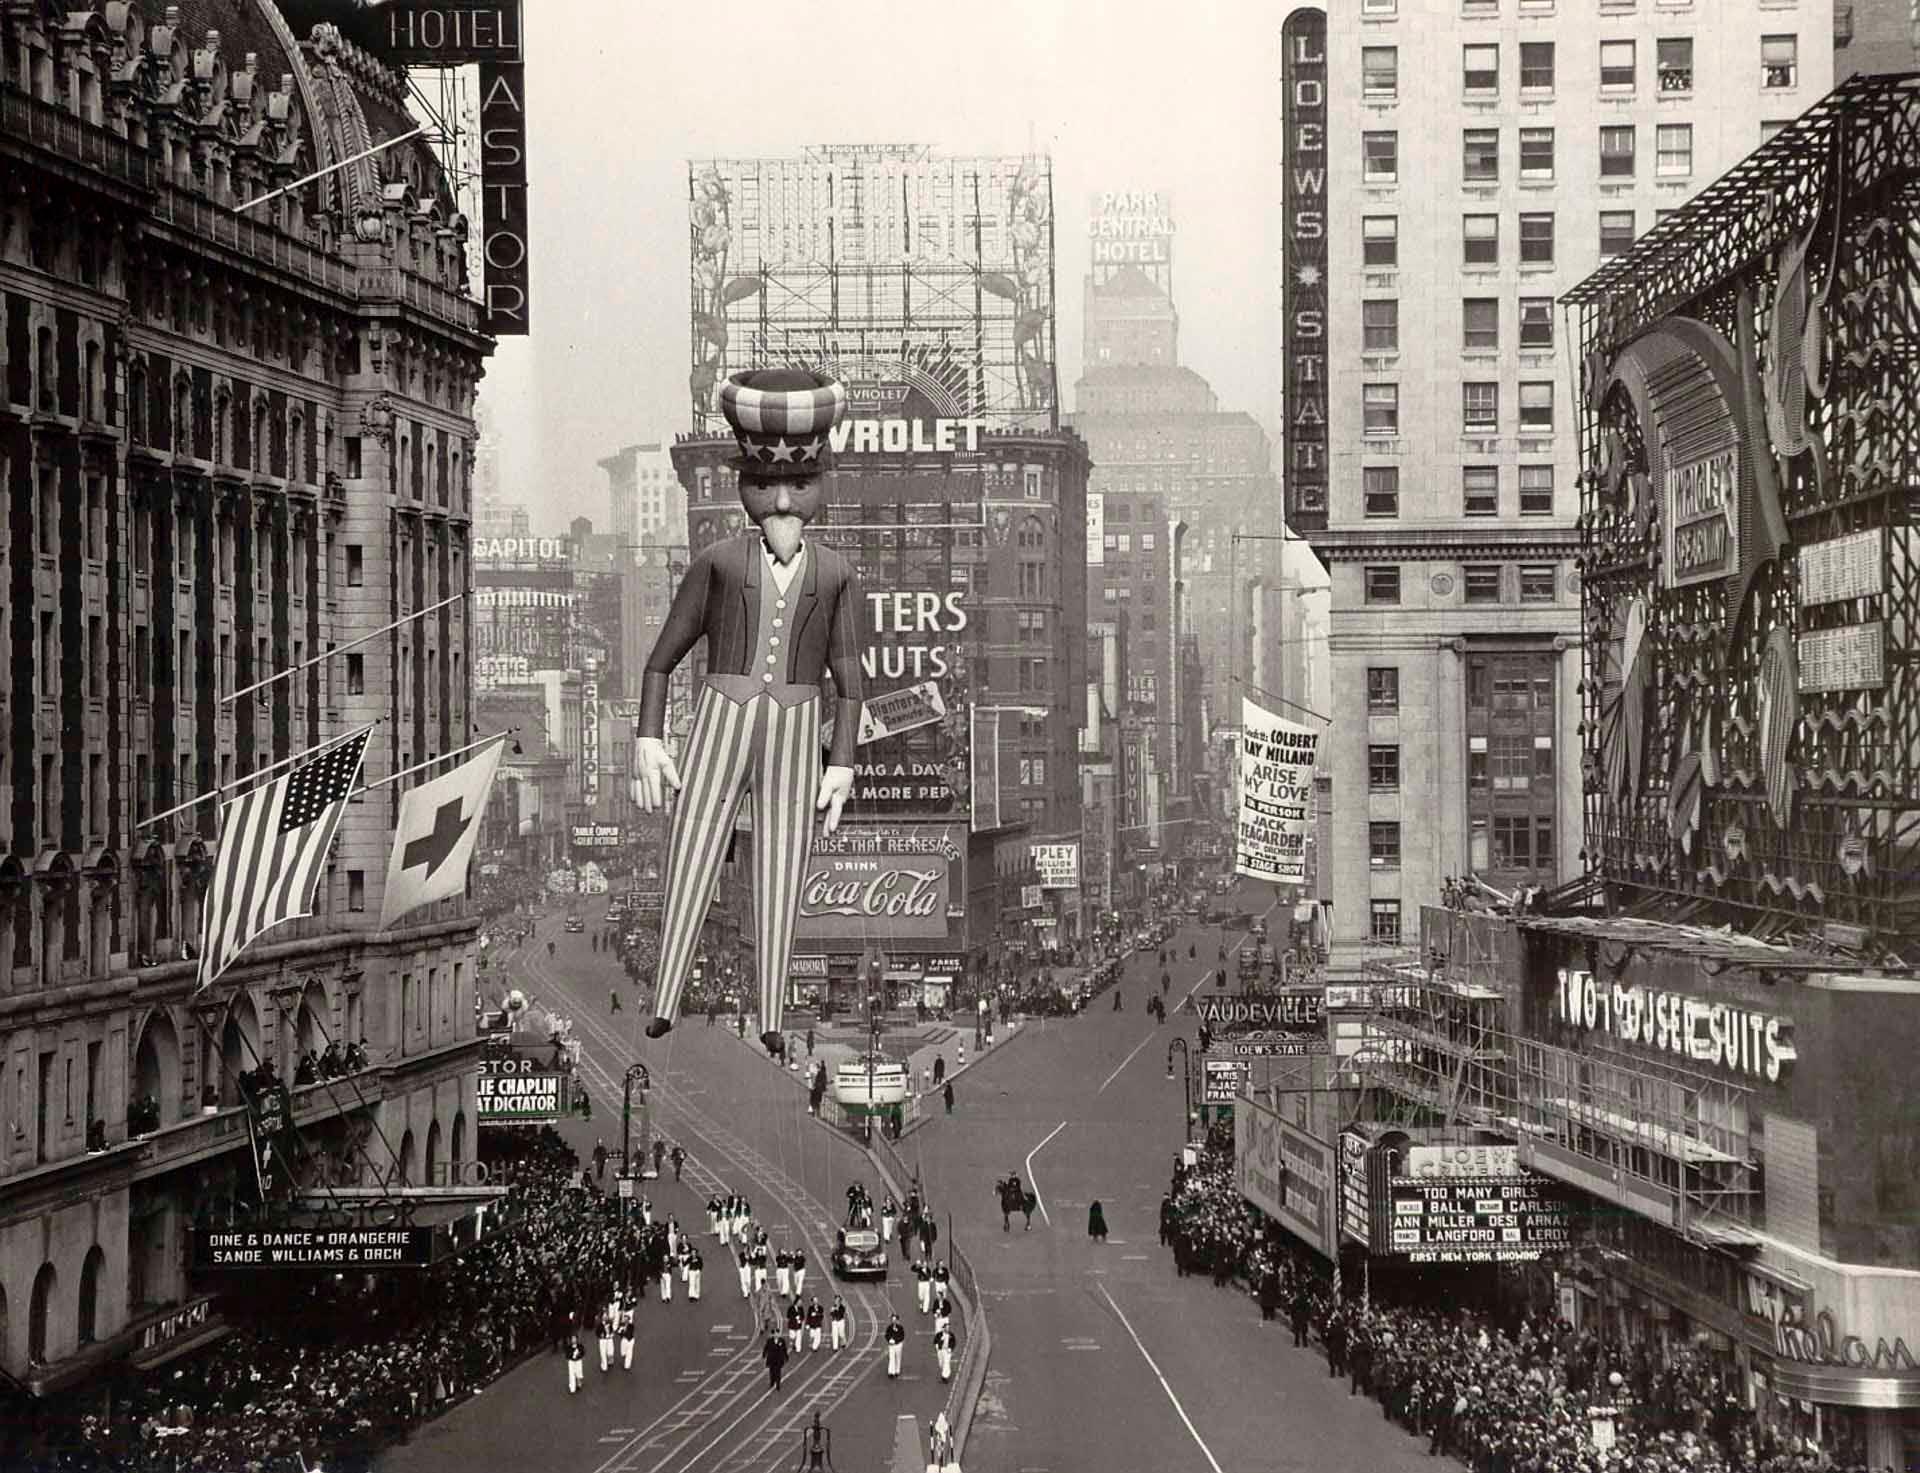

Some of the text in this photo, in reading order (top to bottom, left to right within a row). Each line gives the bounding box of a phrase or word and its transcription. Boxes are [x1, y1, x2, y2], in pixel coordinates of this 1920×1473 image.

[391, 10, 517, 48] HOTEL
[482, 75, 525, 320] ASTOR
[1095, 241, 1167, 261] HOTEL
[1295, 309, 1324, 513] STATE
[829, 419, 985, 453] VROLET
[474, 538, 568, 559] CAPITOL
[866, 591, 967, 632] TERS
[585, 685, 598, 795] CAPITOL
[1270, 729, 1318, 749] COLBERT
[1266, 746, 1315, 767] MILLAND
[912, 764, 945, 776] DAY
[1252, 763, 1298, 786] ARISE
[862, 787, 911, 800] MORE
[1128, 744, 1137, 827] RIVOLI
[1257, 801, 1303, 820] PERSON
[1252, 815, 1286, 832] JACK
[1240, 822, 1304, 849] TEAGARDEN
[835, 861, 878, 871] DRINK
[1197, 1002, 1317, 1023] VAUDEVILLE
[1275, 1044, 1305, 1055] STATE
[1708, 1003, 1781, 1083] SUITS
[498, 1077, 557, 1096] CHAPLIN
[494, 1095, 557, 1112] DICTATOR
[1456, 1187, 1493, 1199] MANY
[1501, 1186, 1539, 1198] GIRLS
[1430, 1201, 1466, 1213] BALL
[1394, 1216, 1420, 1228] ANN
[1428, 1216, 1476, 1228] MILLER
[1488, 1216, 1519, 1228] DESI
[209, 1232, 243, 1247] DINE
[246, 1233, 258, 1246] &
[262, 1232, 312, 1247] DANCE
[328, 1231, 411, 1247] ORANGERIE
[1426, 1229, 1496, 1242] LANGFORD
[1527, 1228, 1569, 1241] LEROY
[213, 1247, 402, 1263] SANDE WILLIAMS & ORCH
[1410, 1252, 1440, 1263] FIRST
[1441, 1251, 1464, 1262] NEW
[1465, 1251, 1492, 1262] YORK
